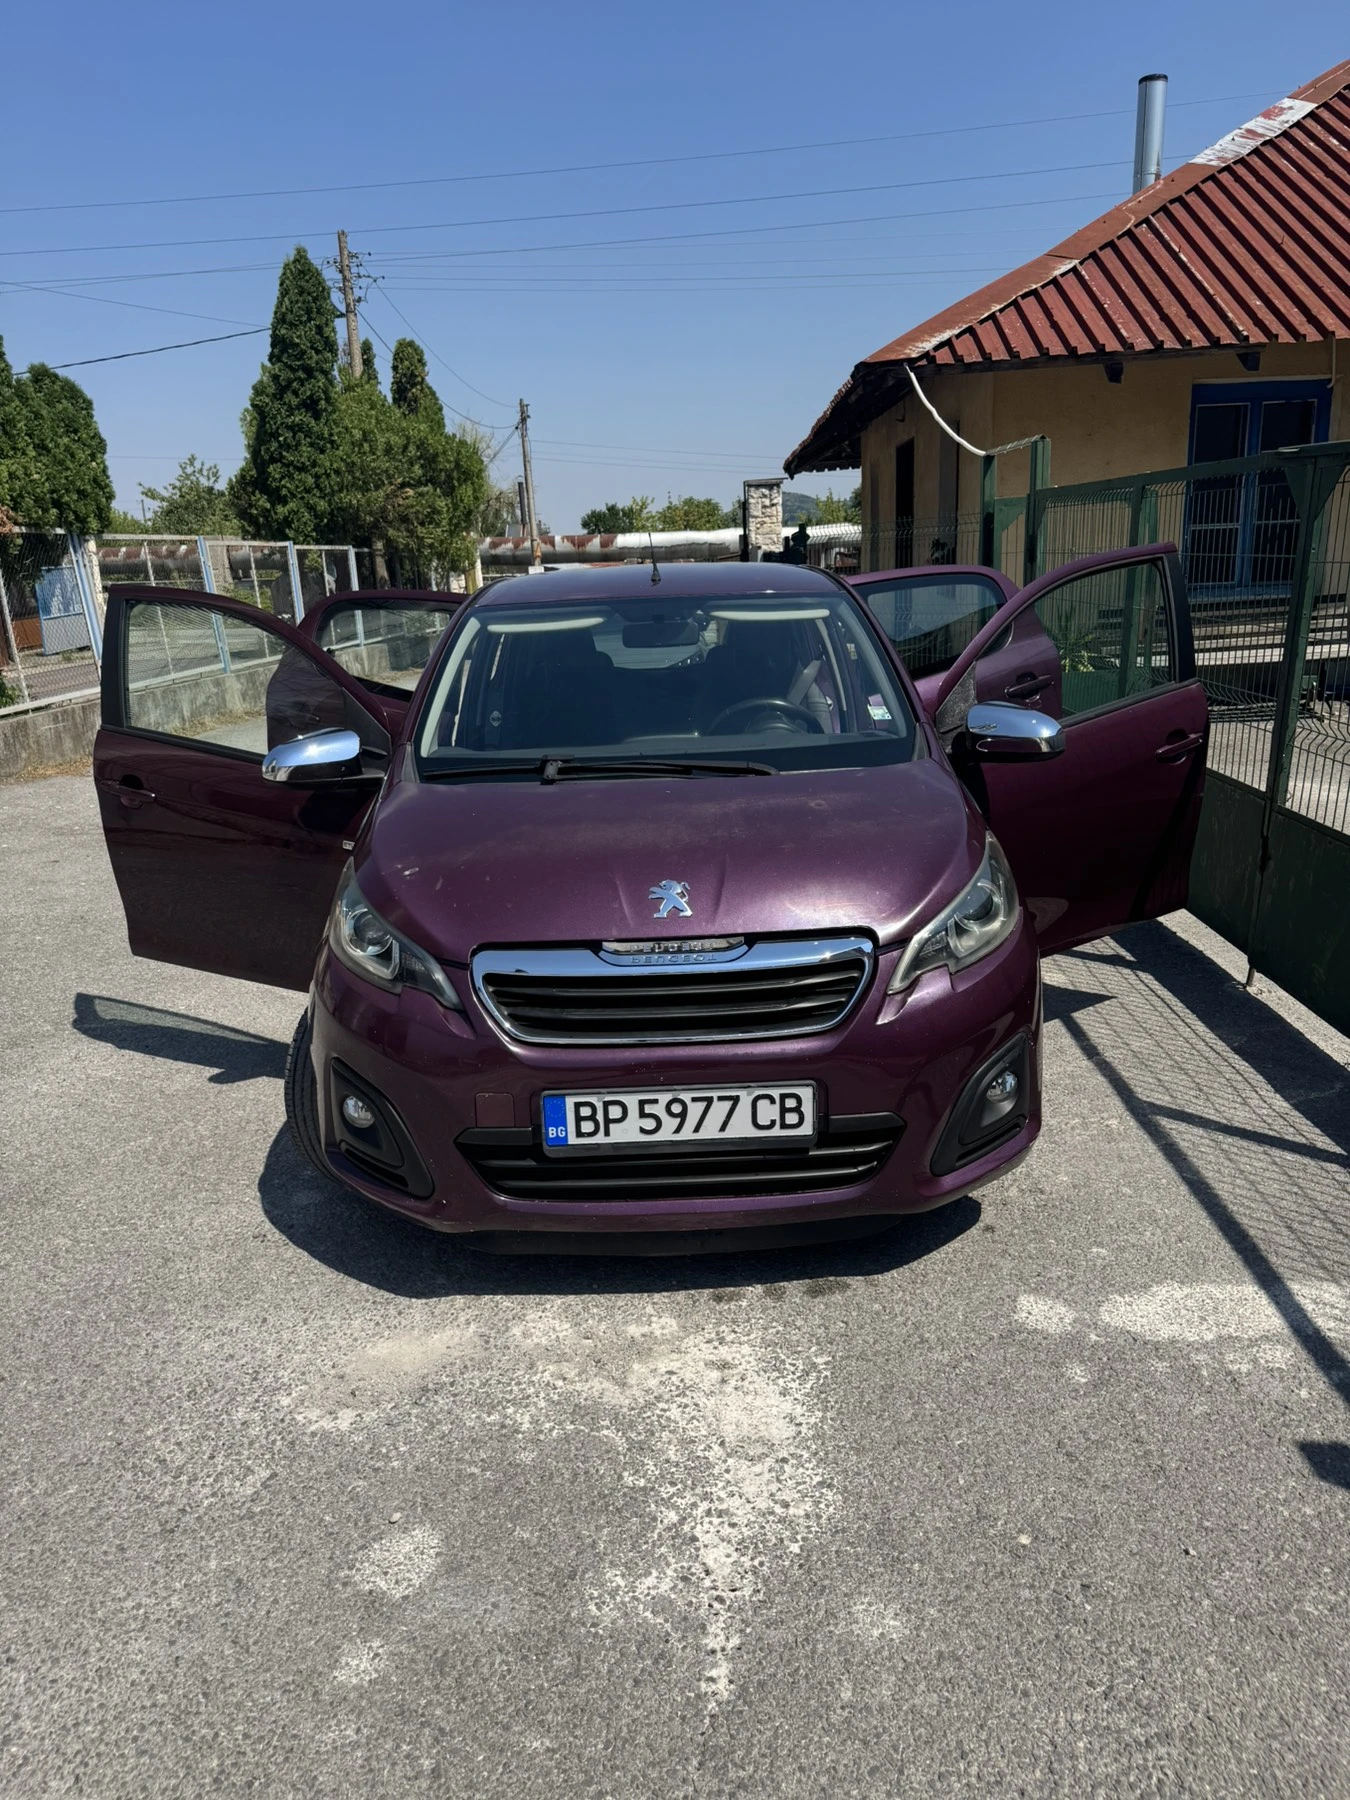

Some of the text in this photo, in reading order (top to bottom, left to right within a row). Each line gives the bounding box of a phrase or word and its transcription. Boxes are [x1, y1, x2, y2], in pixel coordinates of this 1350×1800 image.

[574, 1093, 805, 1138] BP 5977 CB
[548, 1127, 566, 1138] BG
